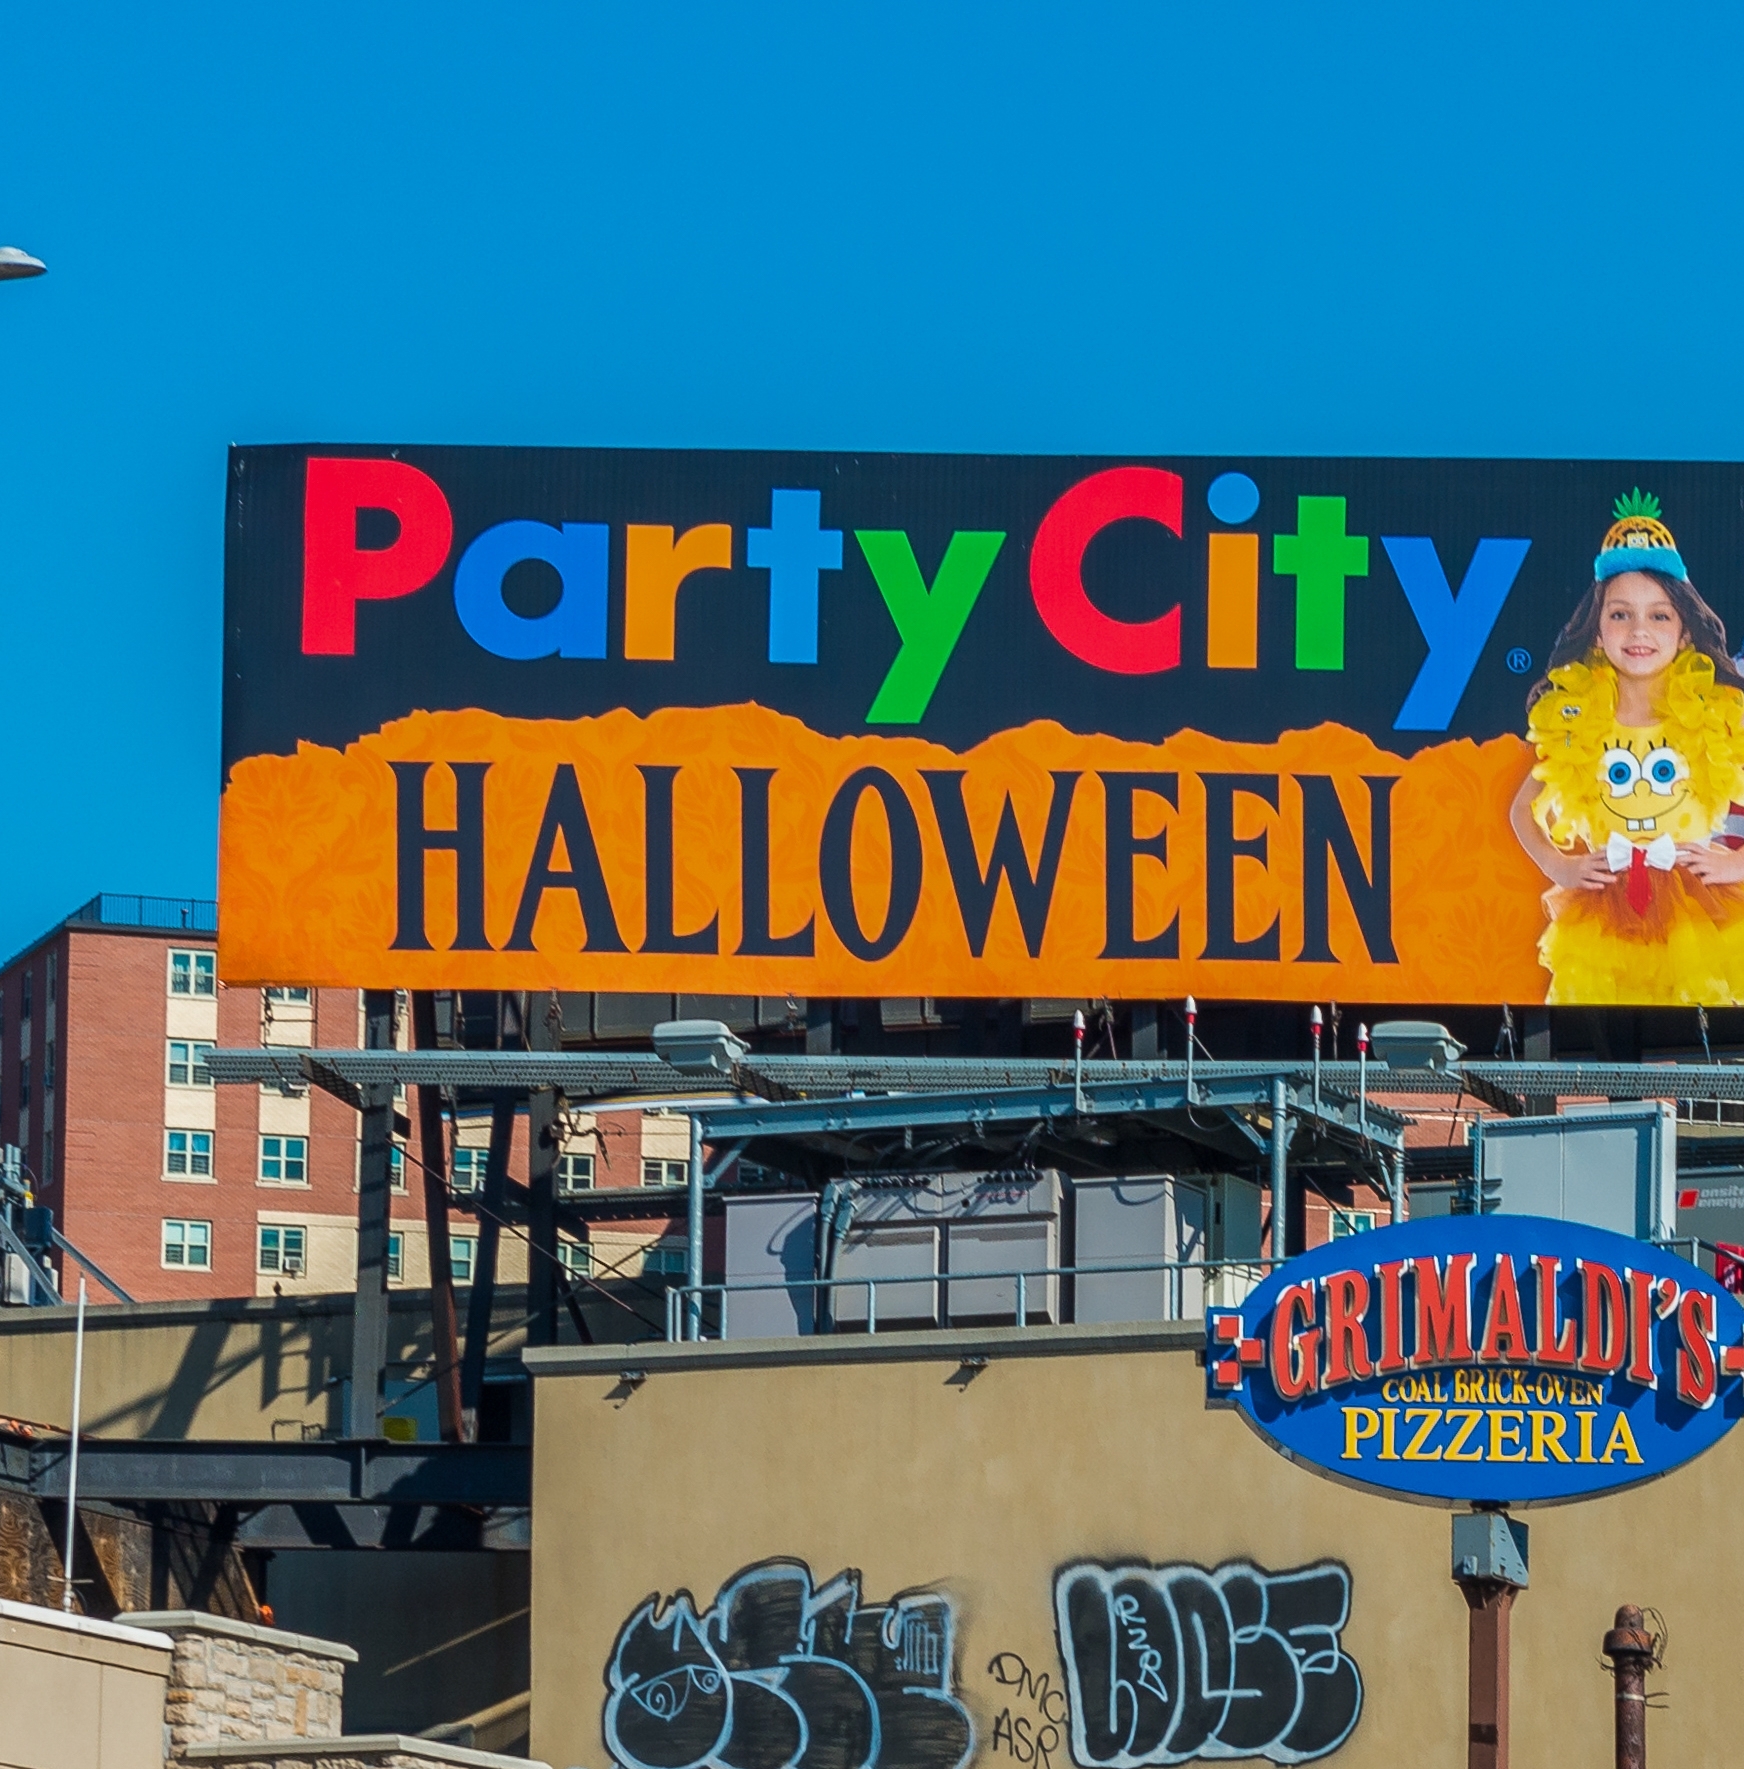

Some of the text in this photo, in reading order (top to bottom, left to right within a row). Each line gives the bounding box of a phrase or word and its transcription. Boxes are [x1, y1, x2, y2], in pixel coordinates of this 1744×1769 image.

[301, 457, 1531, 732] Party City
[390, 759, 1402, 967] HALLOWEEN
[1268, 1253, 1718, 1410] GRIMALDI'S
[1382, 1368, 1604, 1407] COAL BRICK-OVEN
[1342, 1406, 1644, 1464] PIZZERIA
